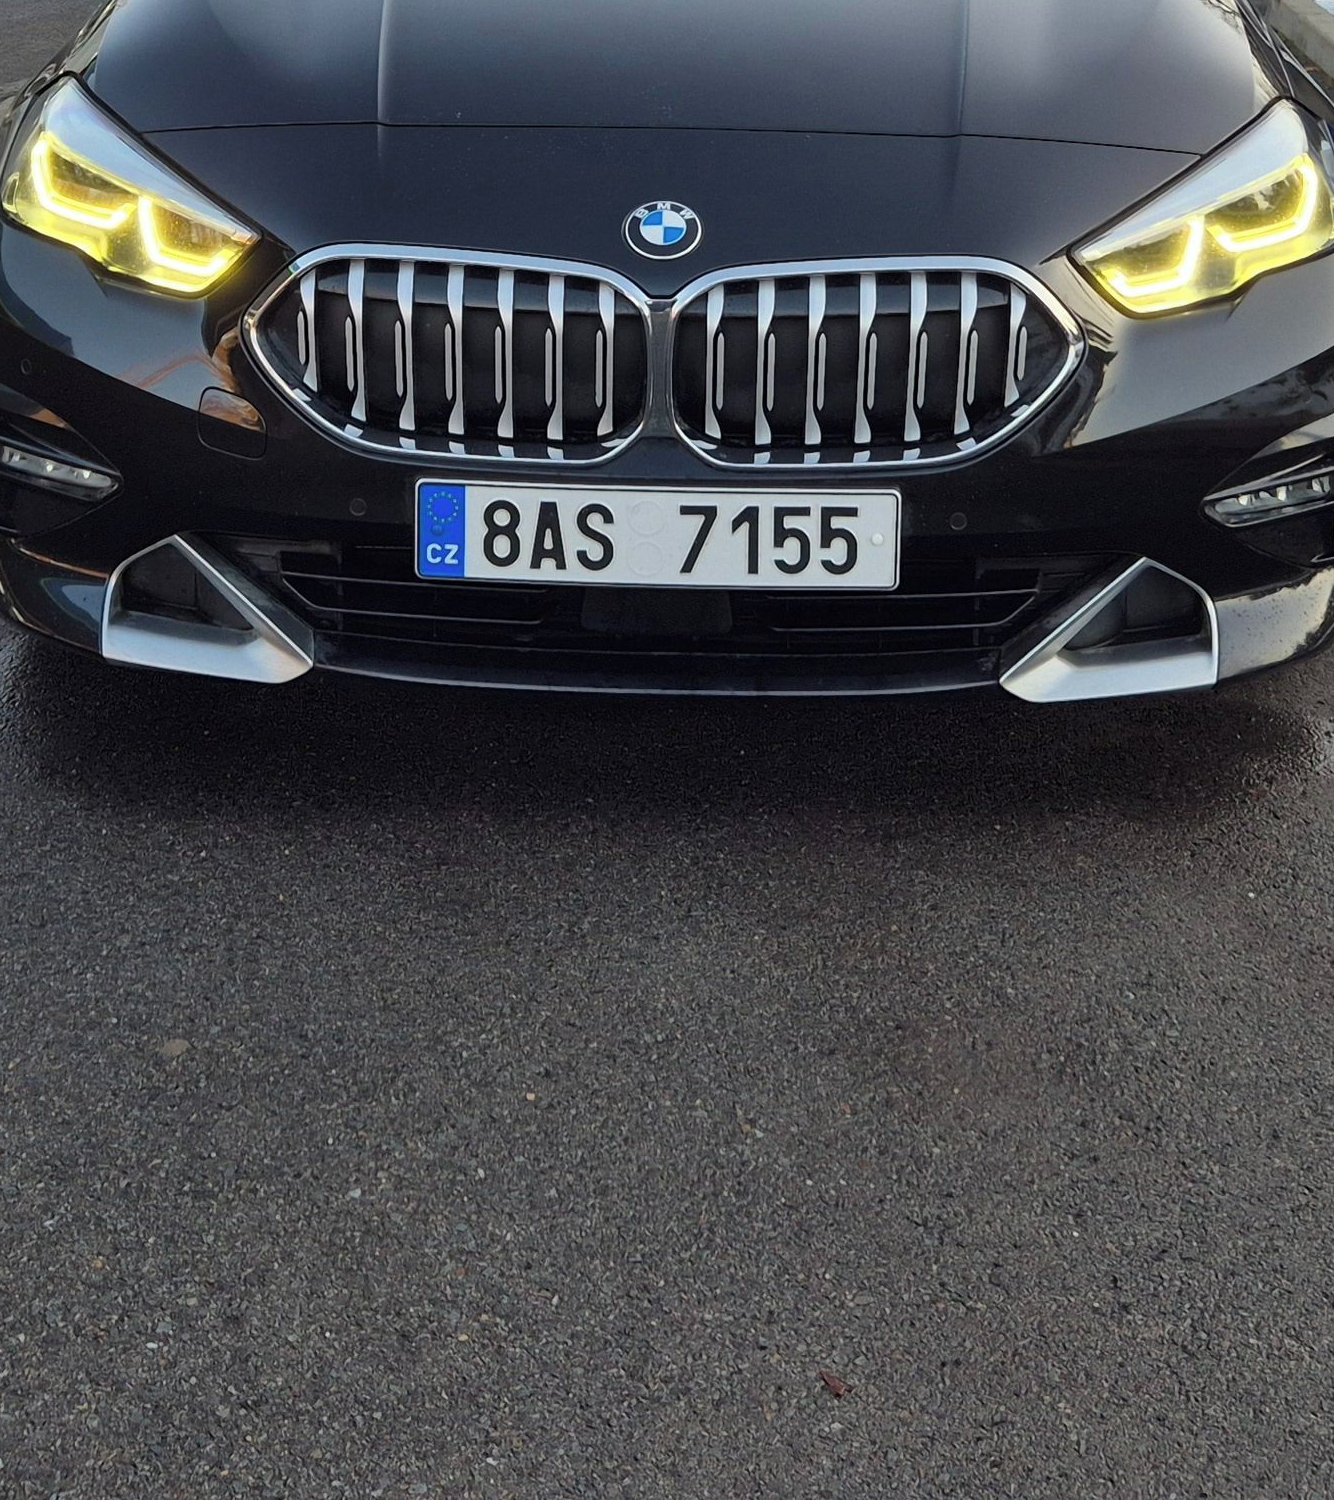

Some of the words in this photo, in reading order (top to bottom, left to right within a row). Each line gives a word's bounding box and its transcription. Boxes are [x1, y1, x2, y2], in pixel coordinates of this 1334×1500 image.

[633, 203, 696, 220] BMW
[483, 500, 615, 571] 8AS
[679, 505, 859, 575] 7155
[426, 543, 459, 565] CZ
